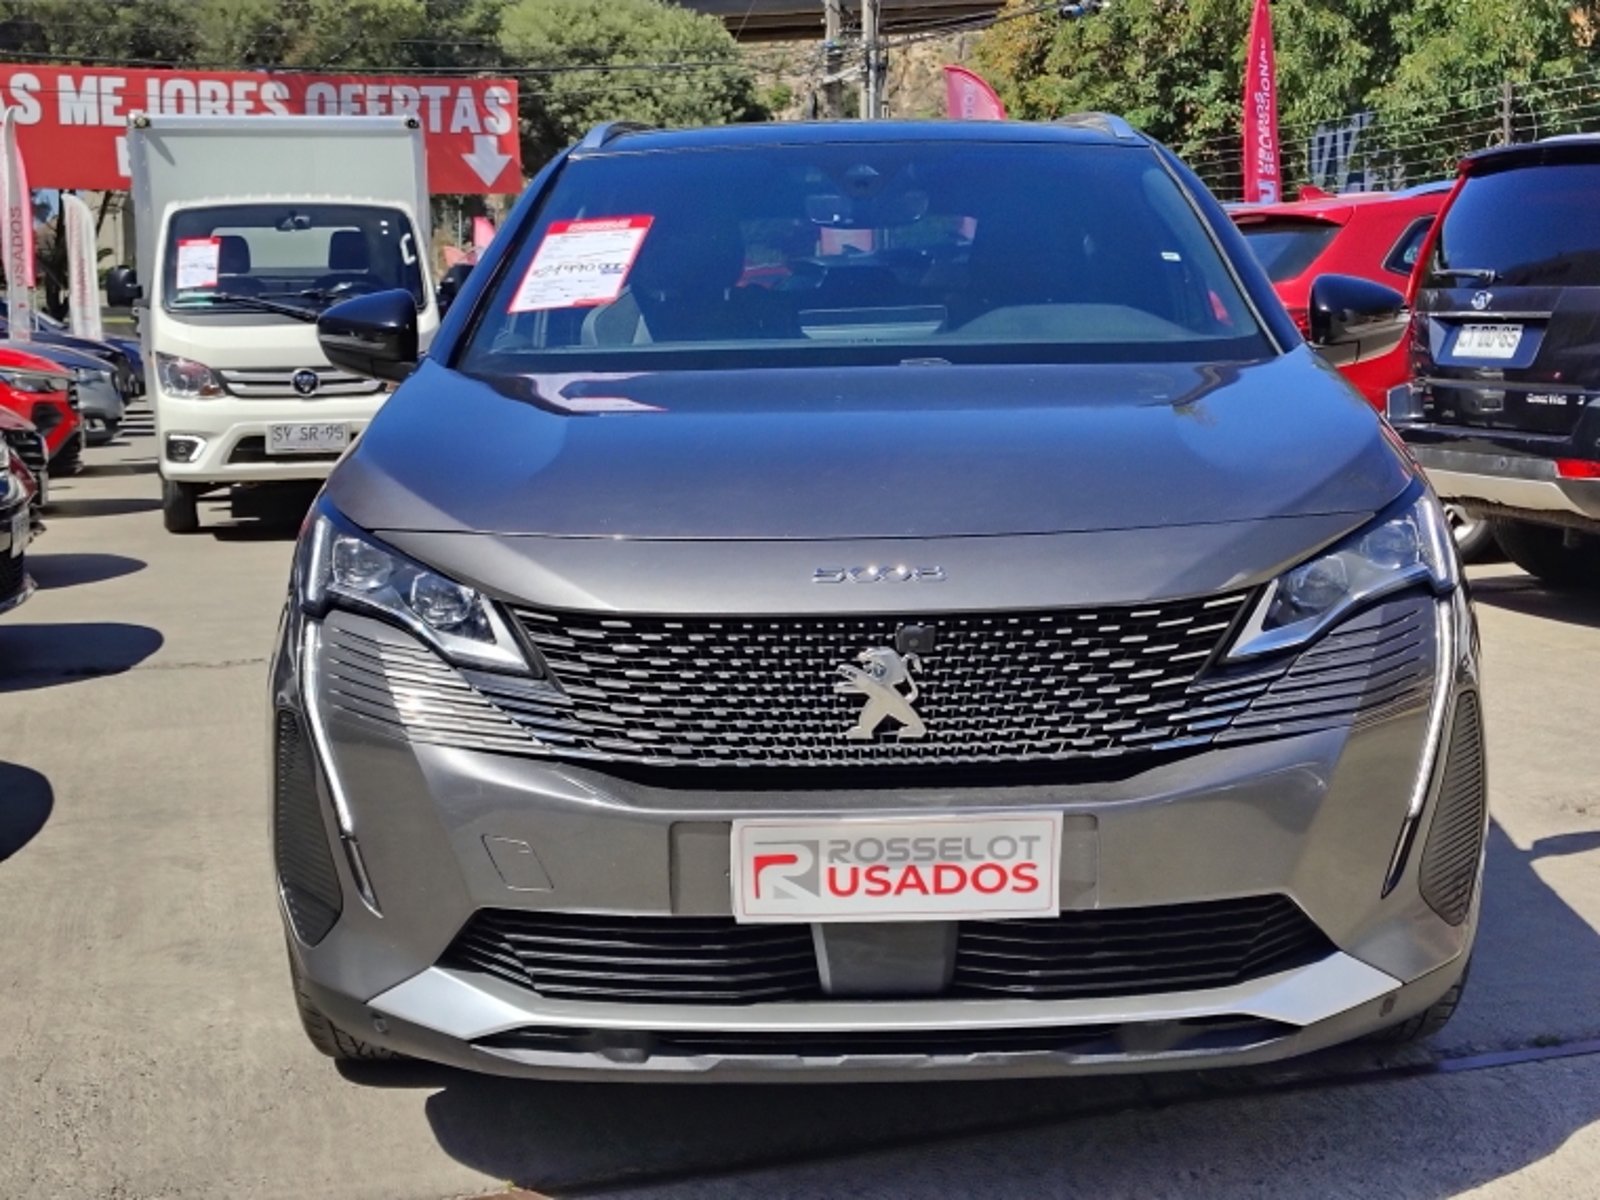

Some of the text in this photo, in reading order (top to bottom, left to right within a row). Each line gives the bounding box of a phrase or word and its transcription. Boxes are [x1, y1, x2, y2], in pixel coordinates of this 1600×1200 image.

[57, 75, 291, 126] MEJORES
[305, 82, 513, 135] OFERTAS
[273, 426, 293, 442] SY
[827, 836, 1041, 863] ROSSELOT
[828, 862, 1039, 897] USADOS
